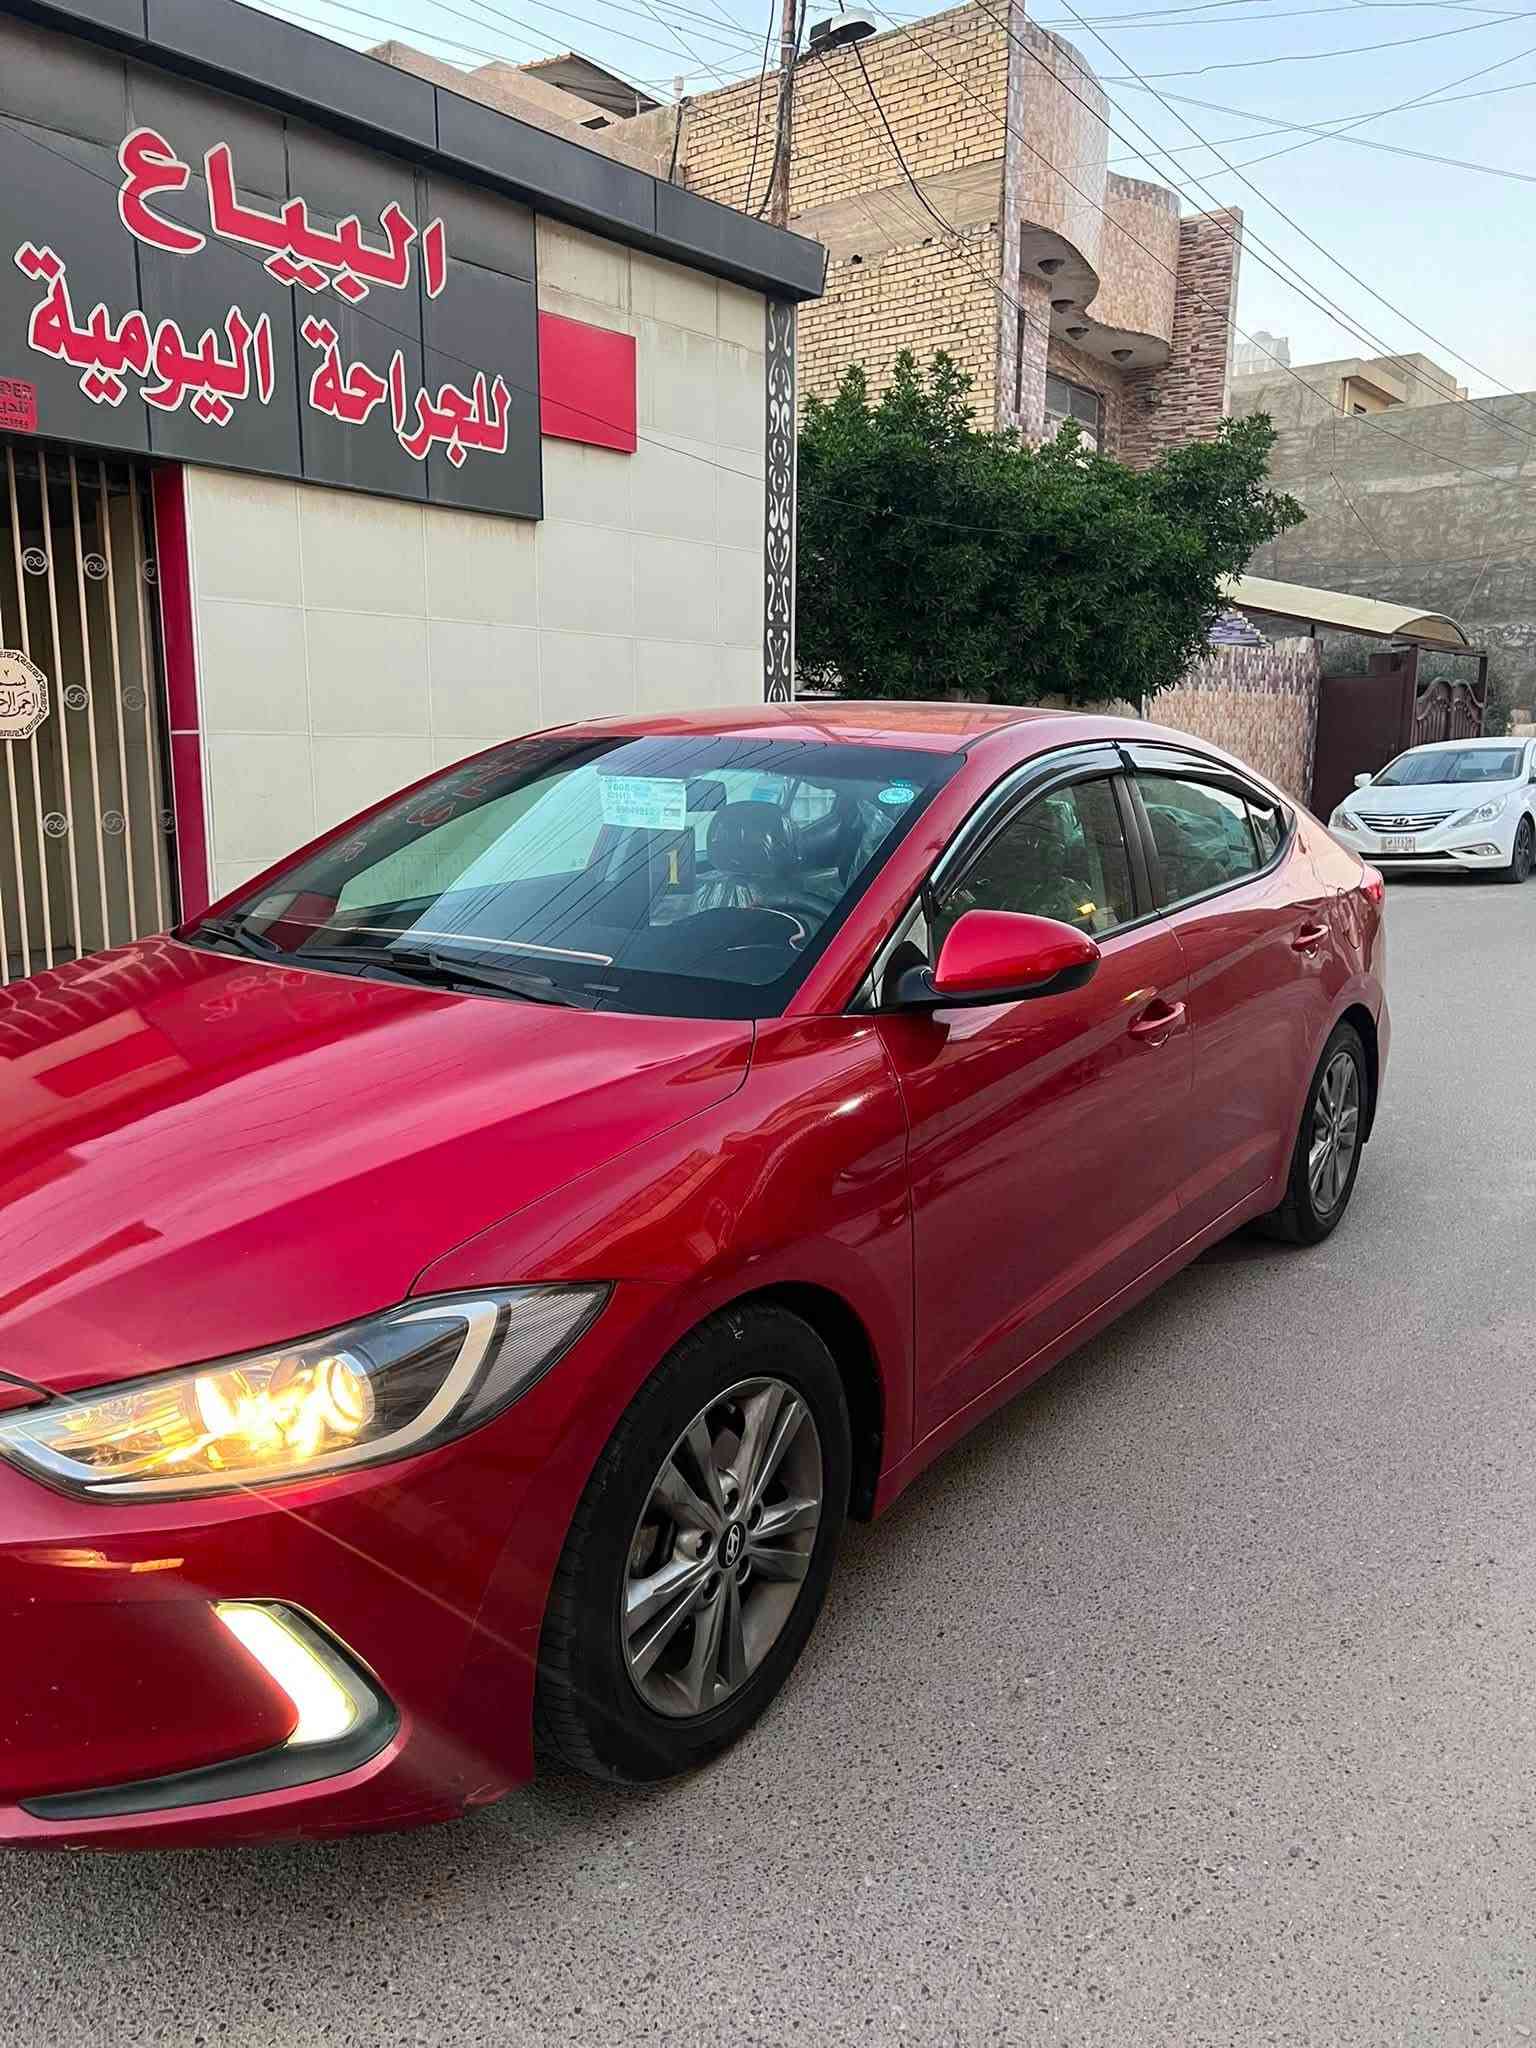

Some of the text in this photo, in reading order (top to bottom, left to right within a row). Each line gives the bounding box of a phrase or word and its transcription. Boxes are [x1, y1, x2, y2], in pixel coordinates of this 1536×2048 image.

[117, 126, 446, 303] البياع
[14, 241, 512, 468] للجراحة اليومية
